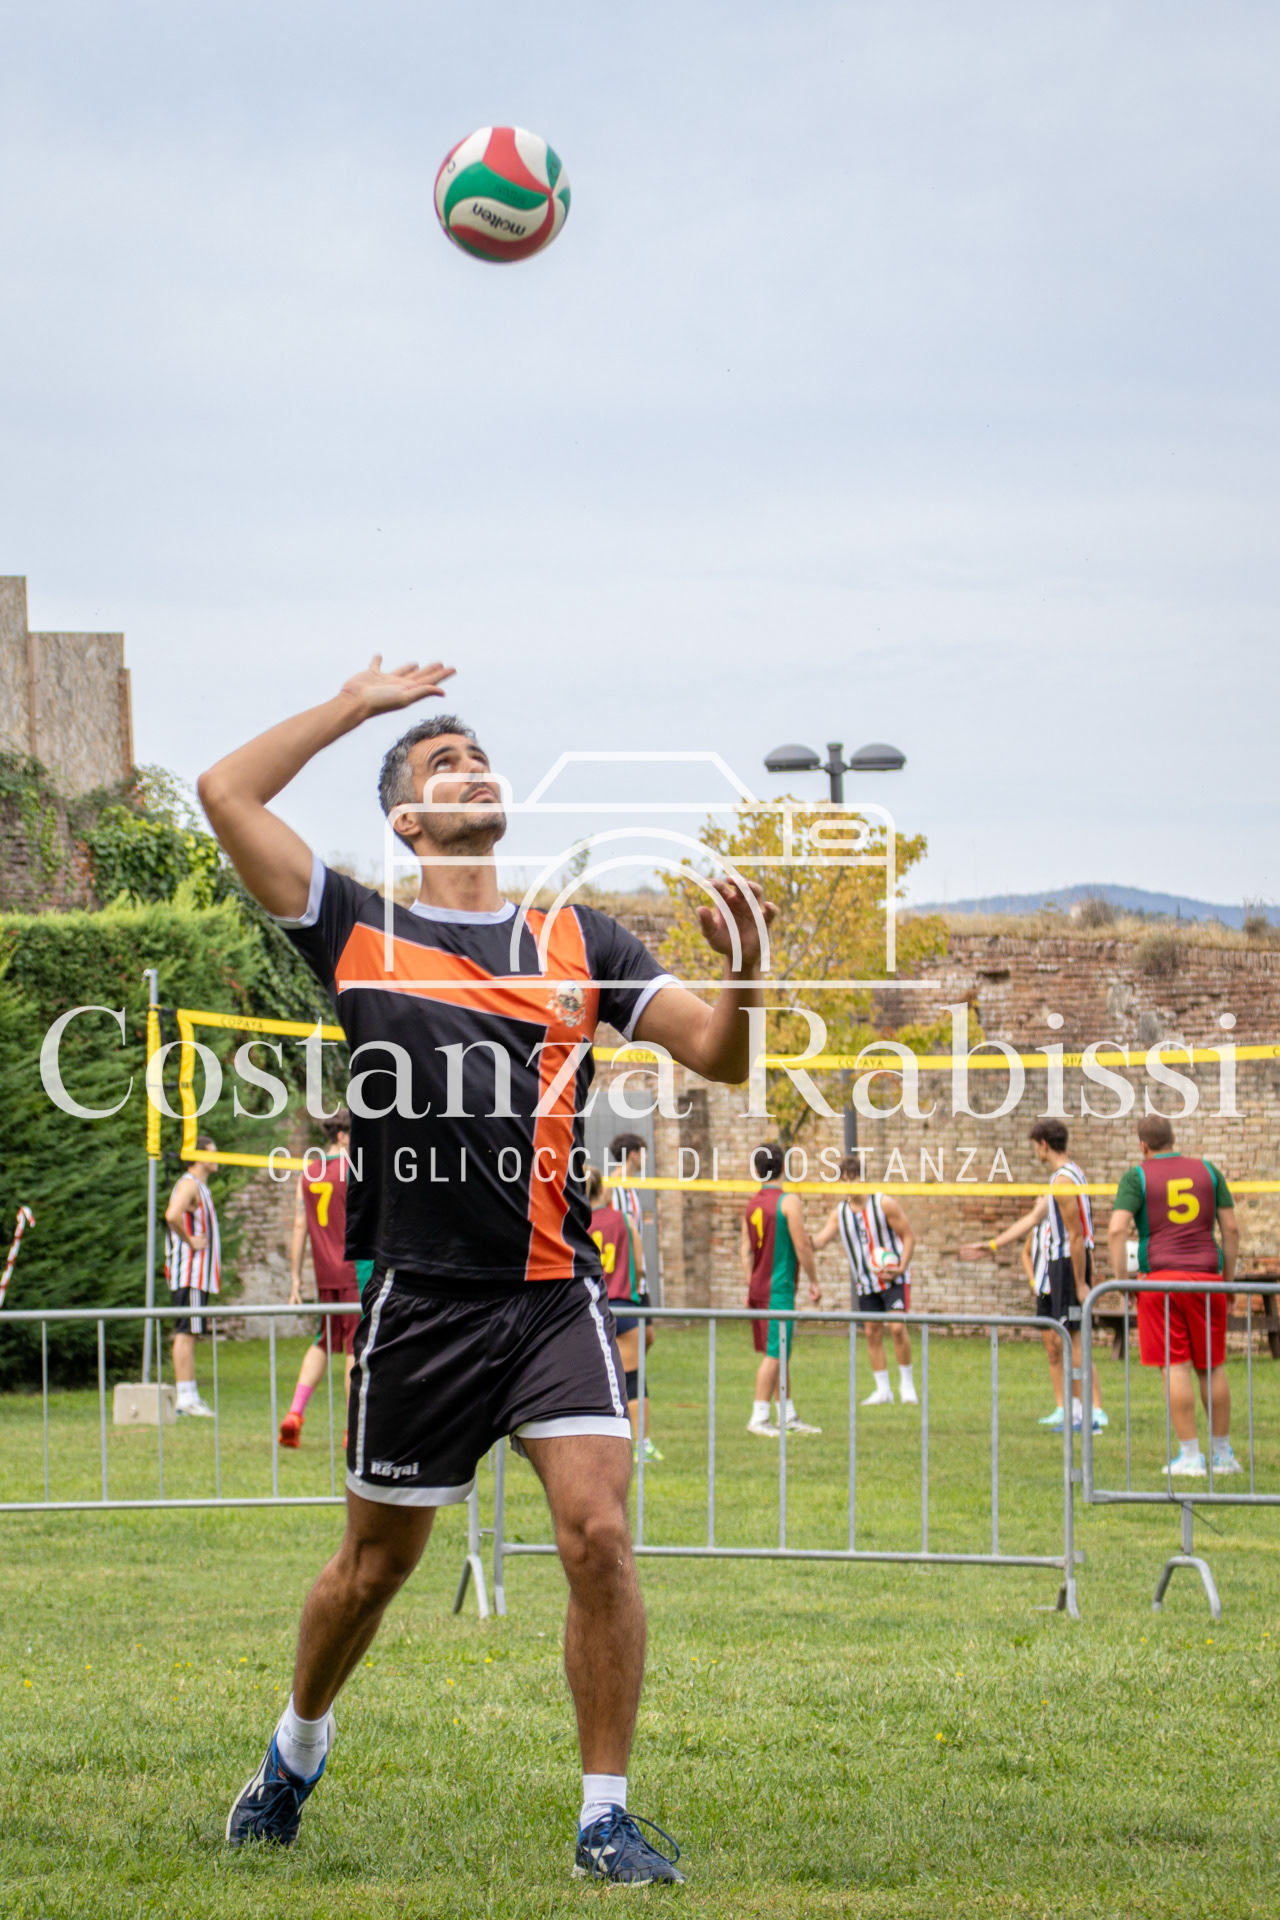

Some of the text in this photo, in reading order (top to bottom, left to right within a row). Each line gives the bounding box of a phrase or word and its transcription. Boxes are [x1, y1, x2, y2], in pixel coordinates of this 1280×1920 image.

[472, 203, 526, 236] molten
[309, 1182, 334, 1228] 7
[1167, 1177, 1200, 1225] 5
[370, 1461, 420, 1479] Royal
